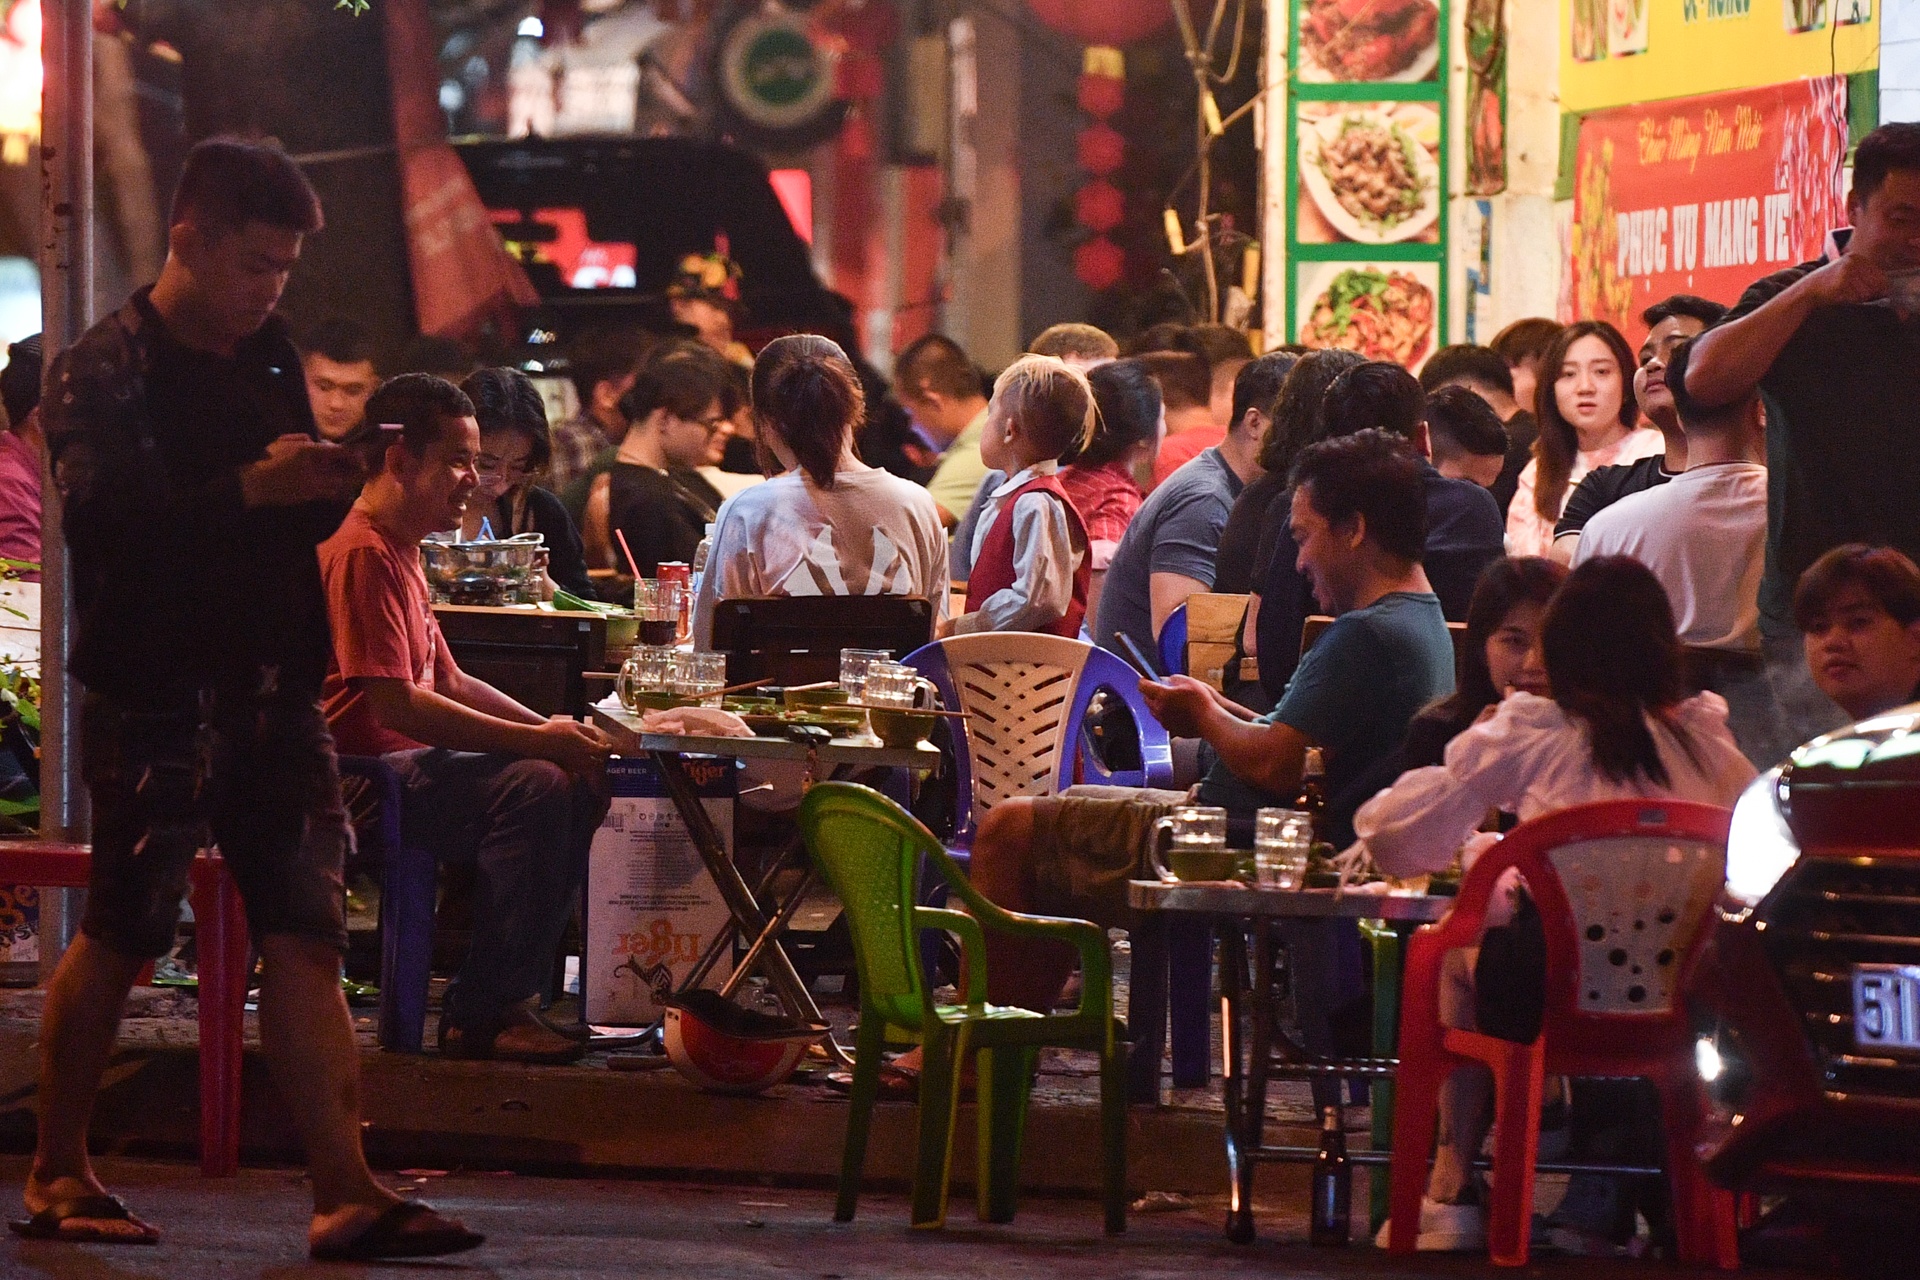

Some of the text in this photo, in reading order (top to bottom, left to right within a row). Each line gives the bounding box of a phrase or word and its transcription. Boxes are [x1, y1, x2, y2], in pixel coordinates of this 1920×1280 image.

[1617, 207, 1668, 292] PHỤC
[1673, 204, 1699, 288] VỤ
[1704, 197, 1759, 268] MANG
[606, 767, 626, 775] AGER
[611, 920, 701, 966] Tiger
[1862, 977, 1920, 1043] 51
